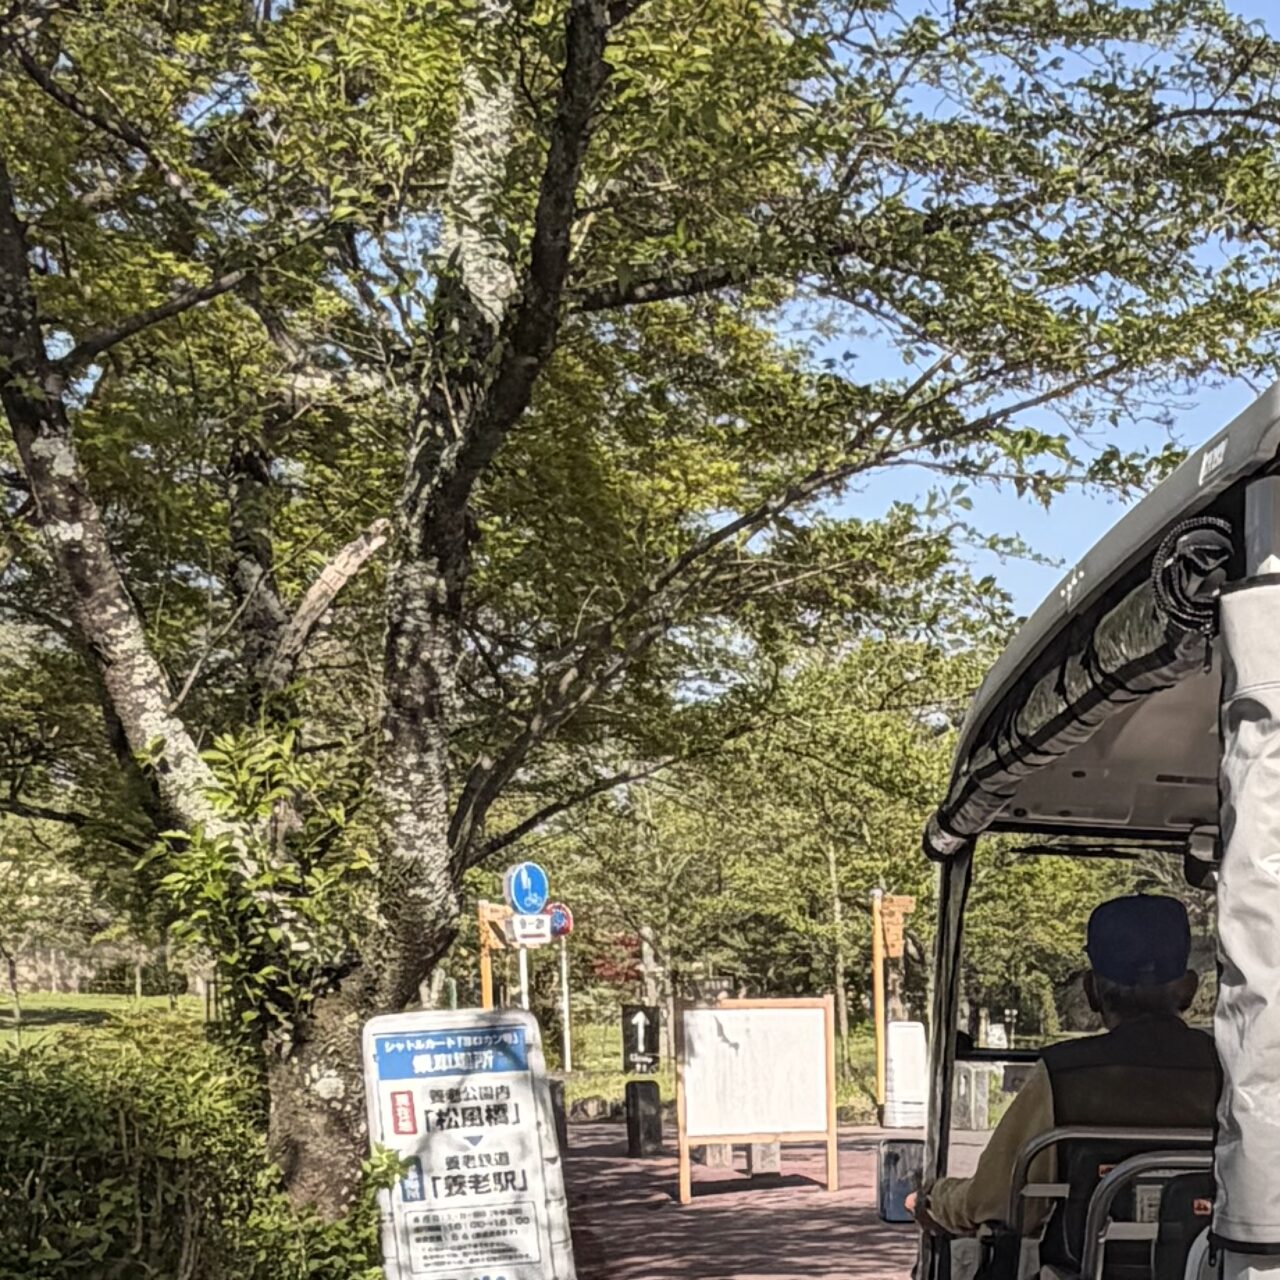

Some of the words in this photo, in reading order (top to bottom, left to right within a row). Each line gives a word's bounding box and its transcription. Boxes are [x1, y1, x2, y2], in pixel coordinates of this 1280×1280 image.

[429, 1085, 510, 1104] 養老公園内
[445, 1151, 510, 1170] 養老鉄道
